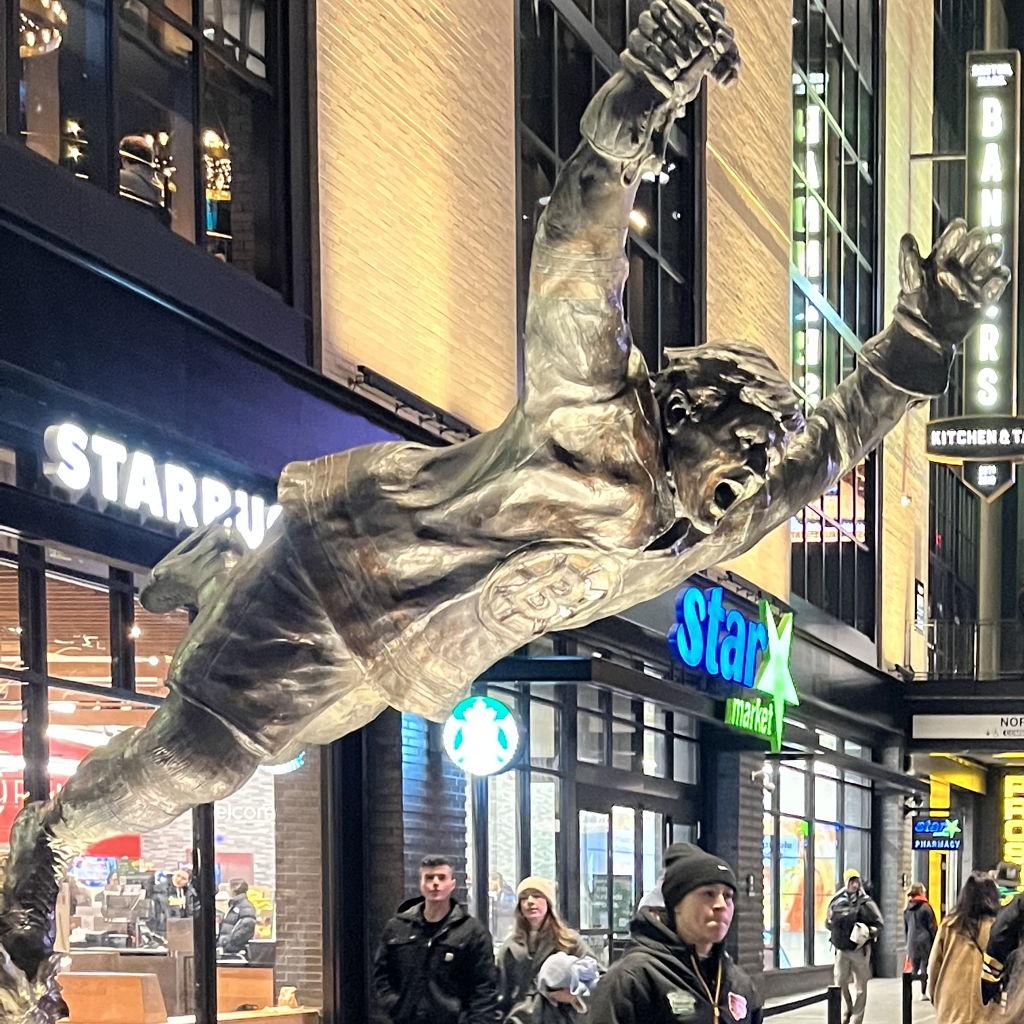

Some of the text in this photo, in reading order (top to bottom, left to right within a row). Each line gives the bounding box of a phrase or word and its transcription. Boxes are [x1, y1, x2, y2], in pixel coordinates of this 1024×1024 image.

[979, 97, 1004, 407] BANRS
[931, 430, 998, 446] KITCHEN
[999, 429, 1011, 445] &
[44, 423, 284, 549] STARBU
[668, 586, 769, 688] Star
[727, 697, 774, 737] market
[214, 800, 275, 820] elcom
[914, 819, 946, 833] star
[914, 839, 961, 849] PHARMACY
